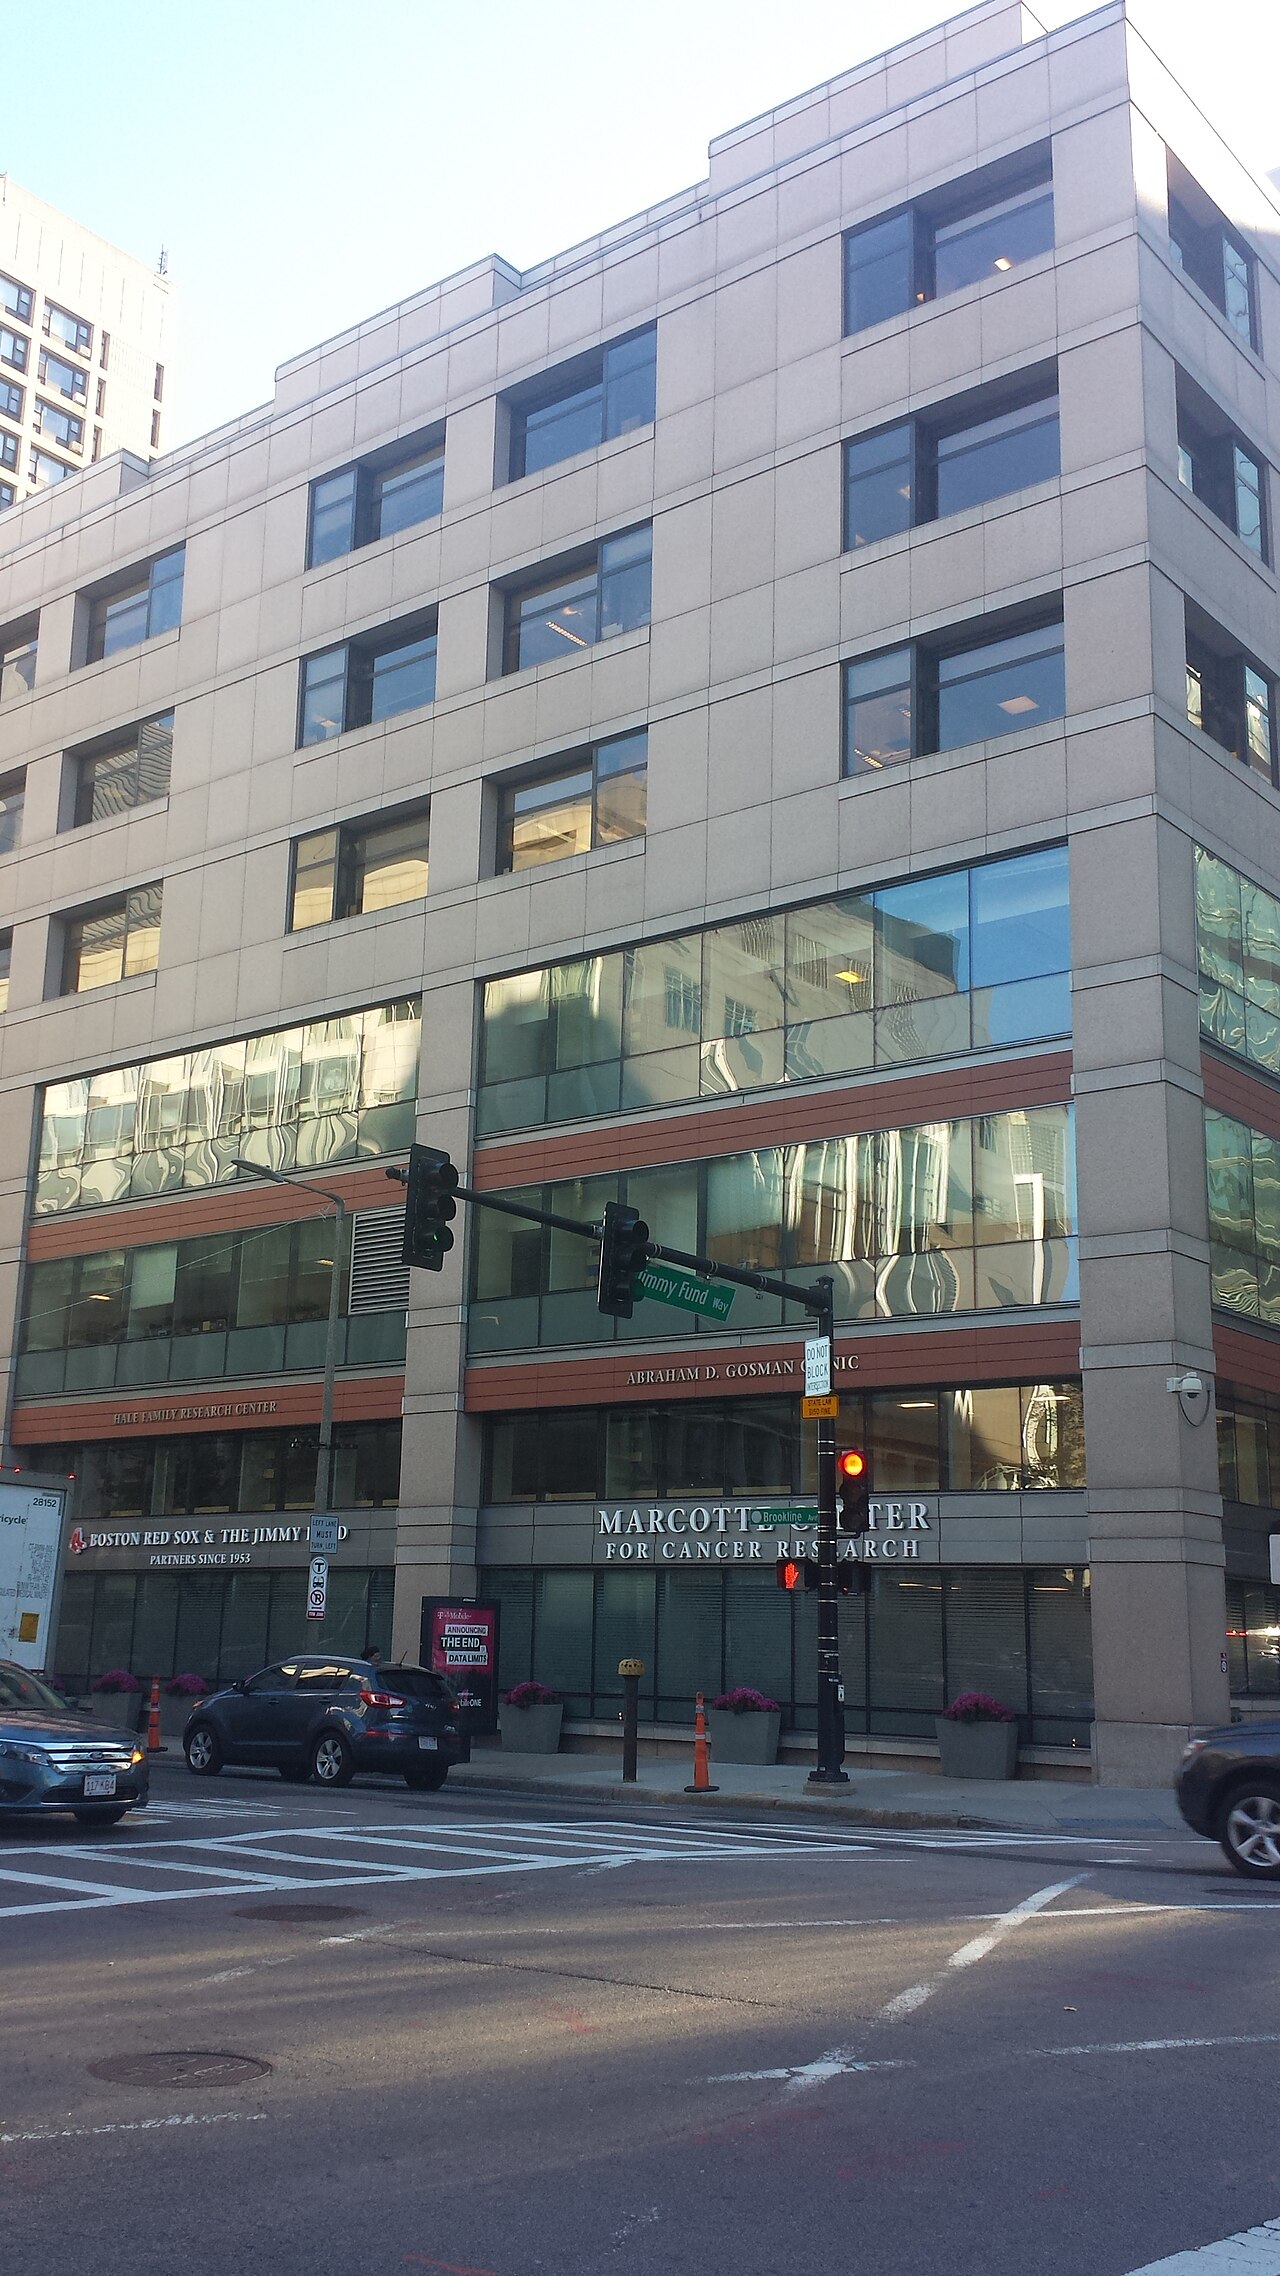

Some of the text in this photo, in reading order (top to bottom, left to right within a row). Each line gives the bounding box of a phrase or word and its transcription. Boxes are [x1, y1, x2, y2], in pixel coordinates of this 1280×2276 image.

[678, 1280, 709, 1305] Fund
[712, 1297, 729, 1313] Way
[807, 1345, 828, 1361] DO NOT
[627, 1355, 859, 1385] ABRAHAM D. GOSMAN CNIC
[807, 1363, 829, 1379] BLOCK
[113, 1401, 277, 1425] HALE FAMILY RESEARCH CENTER
[33, 1497, 57, 1508] 28152
[763, 1511, 803, 1523] Brookline
[312, 1519, 337, 1528] LEFT LANE
[89, 1531, 140, 1547] BOSTON
[143, 1530, 170, 1546] RED
[173, 1530, 200, 1545] SOX
[204, 1529, 215, 1544] &
[221, 1528, 250, 1543] THE
[252, 1526, 301, 1545] JIMMY
[316, 1530, 332, 1539] MUST
[325, 1542, 336, 1550] LEFT
[606, 1539, 919, 1559] FOR CANCER RESARCH
[150, 1552, 251, 1565] PARTNERS SINCE 1953
[447, 1626, 486, 1635] ANNOUNCING
[441, 1637, 480, 1648] THE END
[448, 1654, 487, 1663] DATA LIMITS
